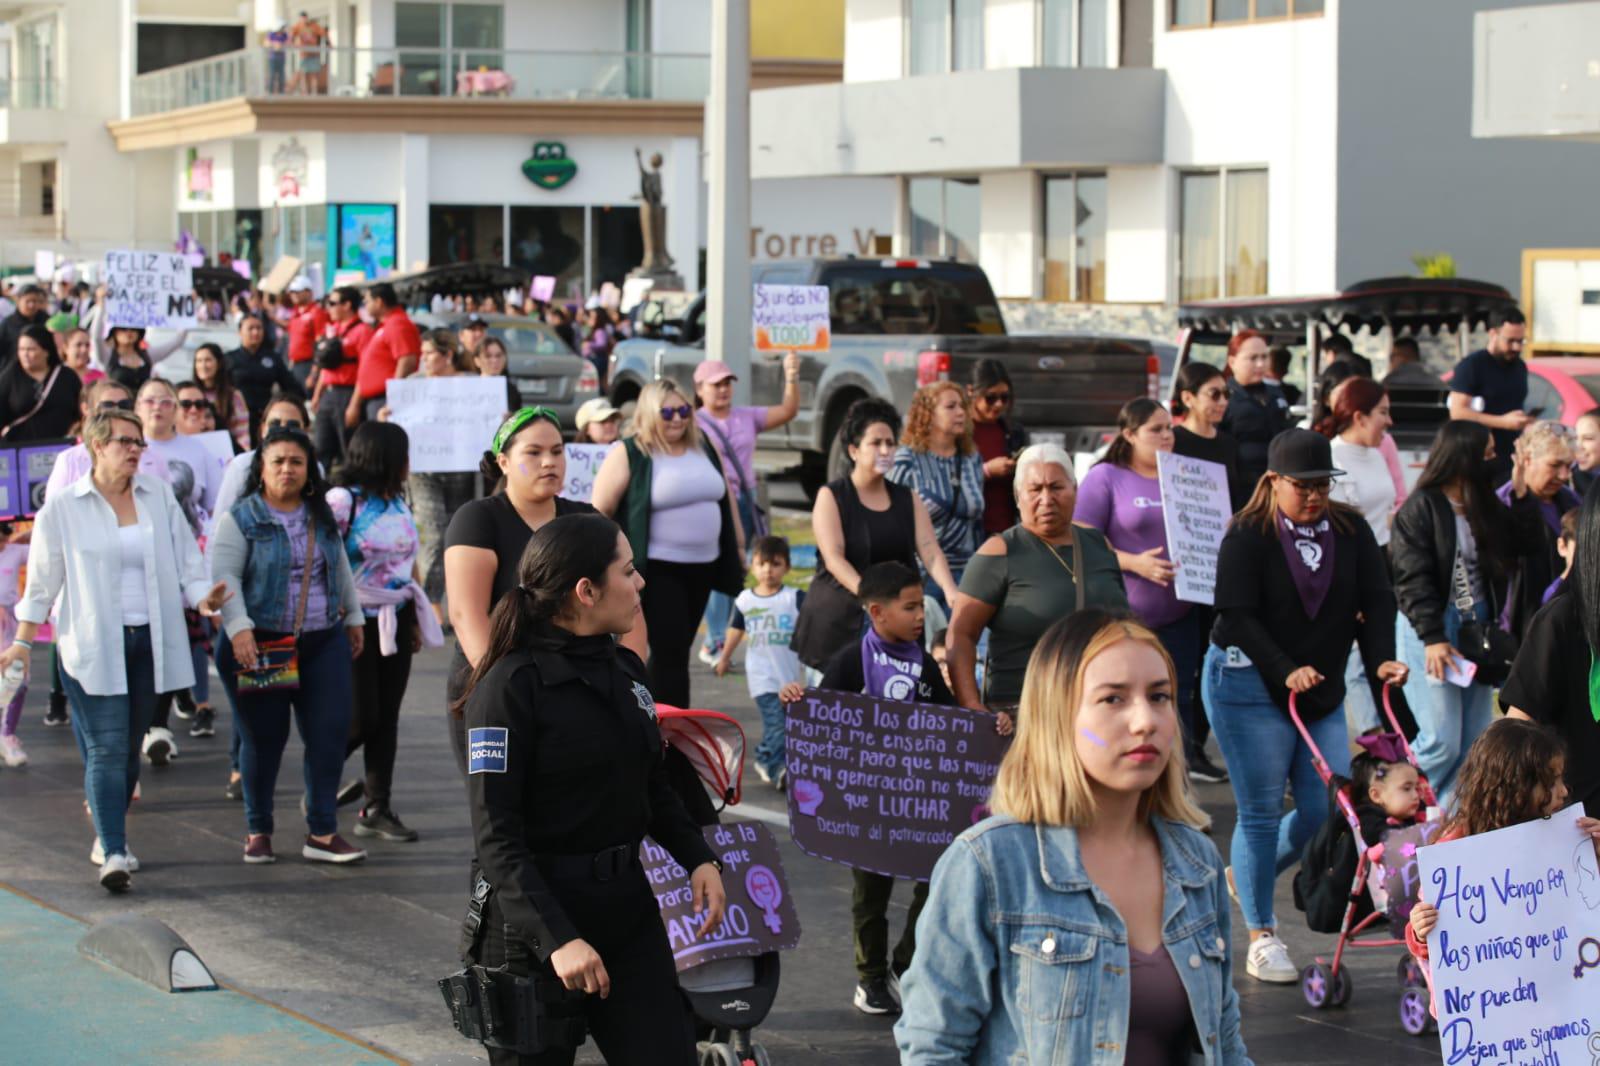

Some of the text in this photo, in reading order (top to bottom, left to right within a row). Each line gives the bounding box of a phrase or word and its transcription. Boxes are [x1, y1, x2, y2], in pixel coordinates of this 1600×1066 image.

[749, 226, 837, 258] Torre
[106, 252, 159, 273] FELIZ
[107, 273, 179, 292] A SER EL
[133, 289, 159, 306] QUE
[167, 293, 195, 318] NO
[770, 326, 811, 345] TODO
[567, 447, 590, 470] Voy
[806, 698, 864, 727] Todos
[873, 703, 900, 729] los
[952, 715, 974, 734] mi
[471, 748, 505, 760] SOCIAL
[849, 729, 876, 746] me
[883, 735, 947, 754] enseña
[957, 740, 968, 754] a
[789, 757, 808, 775] de
[812, 764, 832, 781] mi
[836, 769, 925, 790] generación
[931, 779, 950, 794] no
[859, 749, 897, 769] para
[902, 756, 932, 777] que
[938, 756, 960, 773] las
[843, 793, 950, 822] que LUCHAR
[714, 825, 735, 847] de
[737, 823, 757, 842] la
[816, 815, 954, 847] Desertor del patriarcado
[721, 848, 750, 873] que
[1432, 865, 1487, 924] Hoy
[1491, 868, 1544, 916] Vengo
[1438, 925, 1569, 972] las niñas que ya
[1444, 986, 1475, 1015] No
[1441, 1017, 1498, 1066] Dejen
[1503, 1037, 1527, 1063] que
